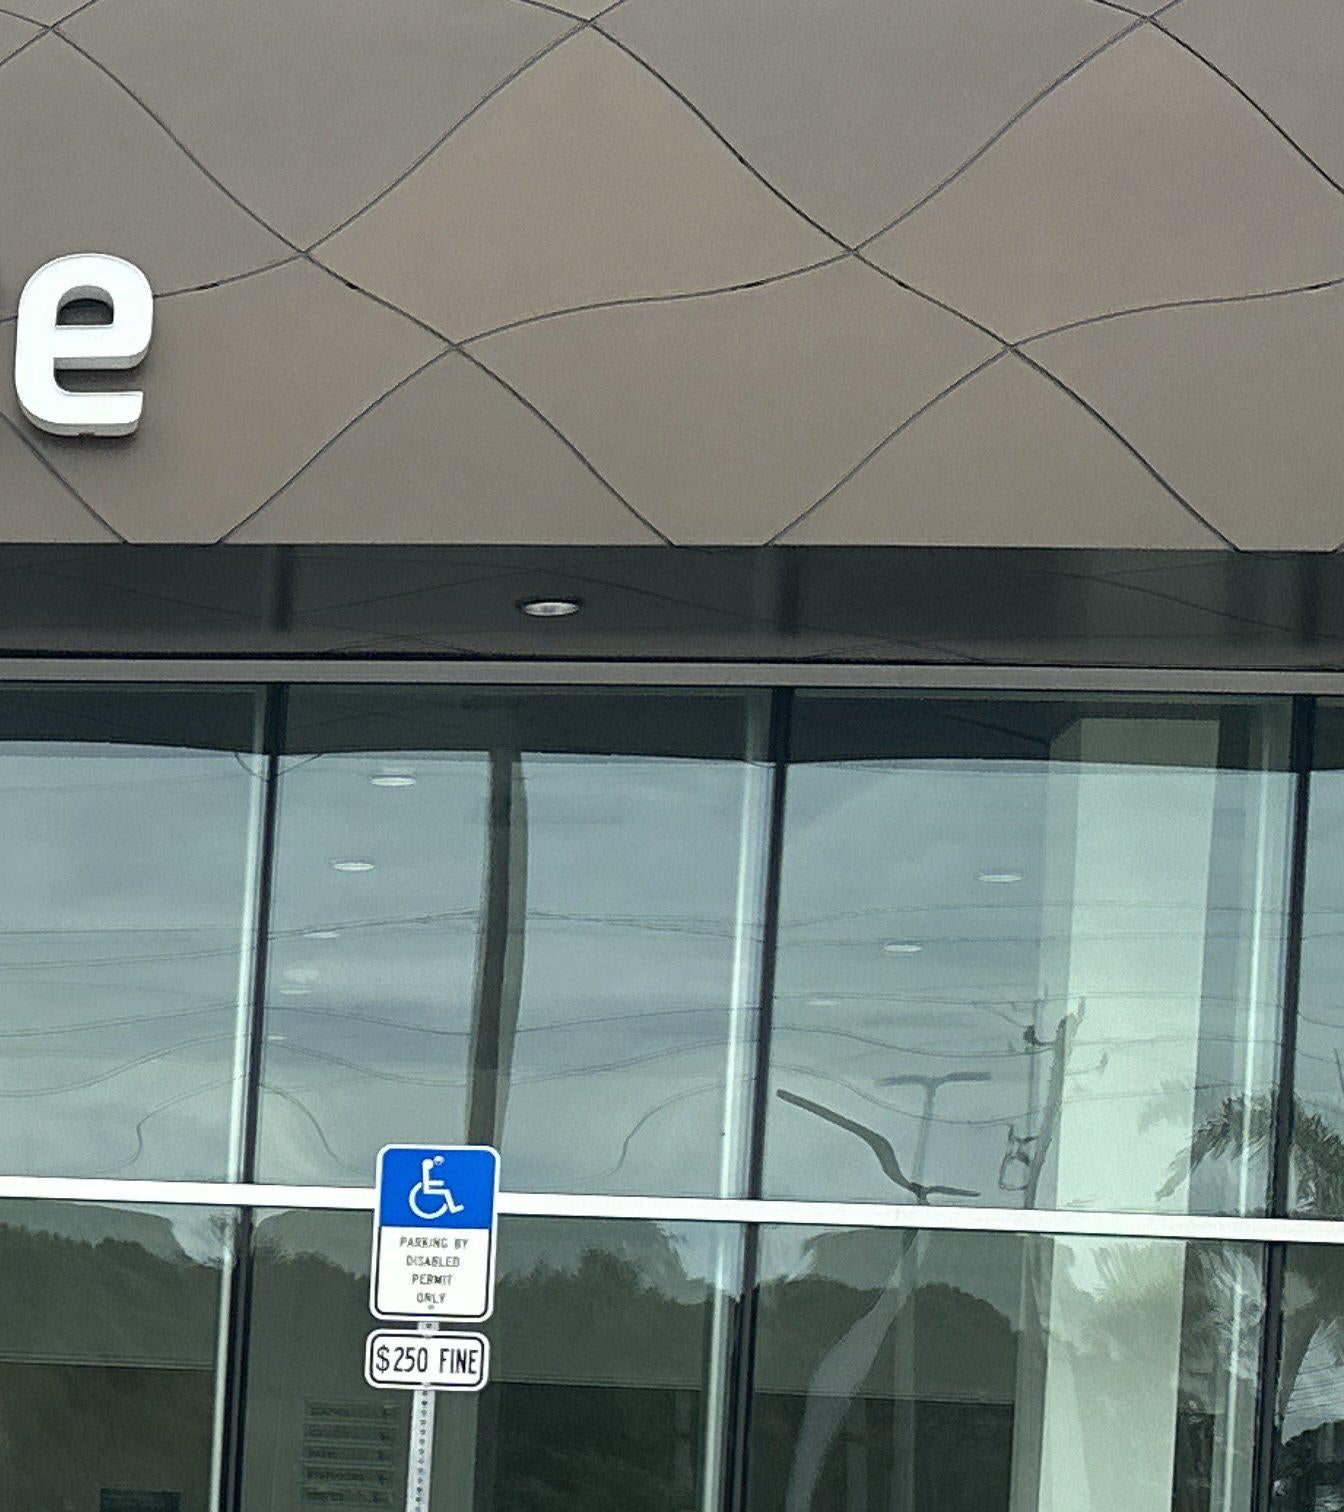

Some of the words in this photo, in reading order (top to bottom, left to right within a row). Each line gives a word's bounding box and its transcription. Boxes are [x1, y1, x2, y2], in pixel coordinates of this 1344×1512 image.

[399, 1236, 448, 1249] PARKING
[454, 1238, 469, 1249] BY
[406, 1255, 461, 1268] DISABLED
[411, 1273, 452, 1286] PERMIT
[416, 1292, 446, 1304] ONLY
[375, 1345, 429, 1374] $250
[439, 1348, 479, 1375] FINE
